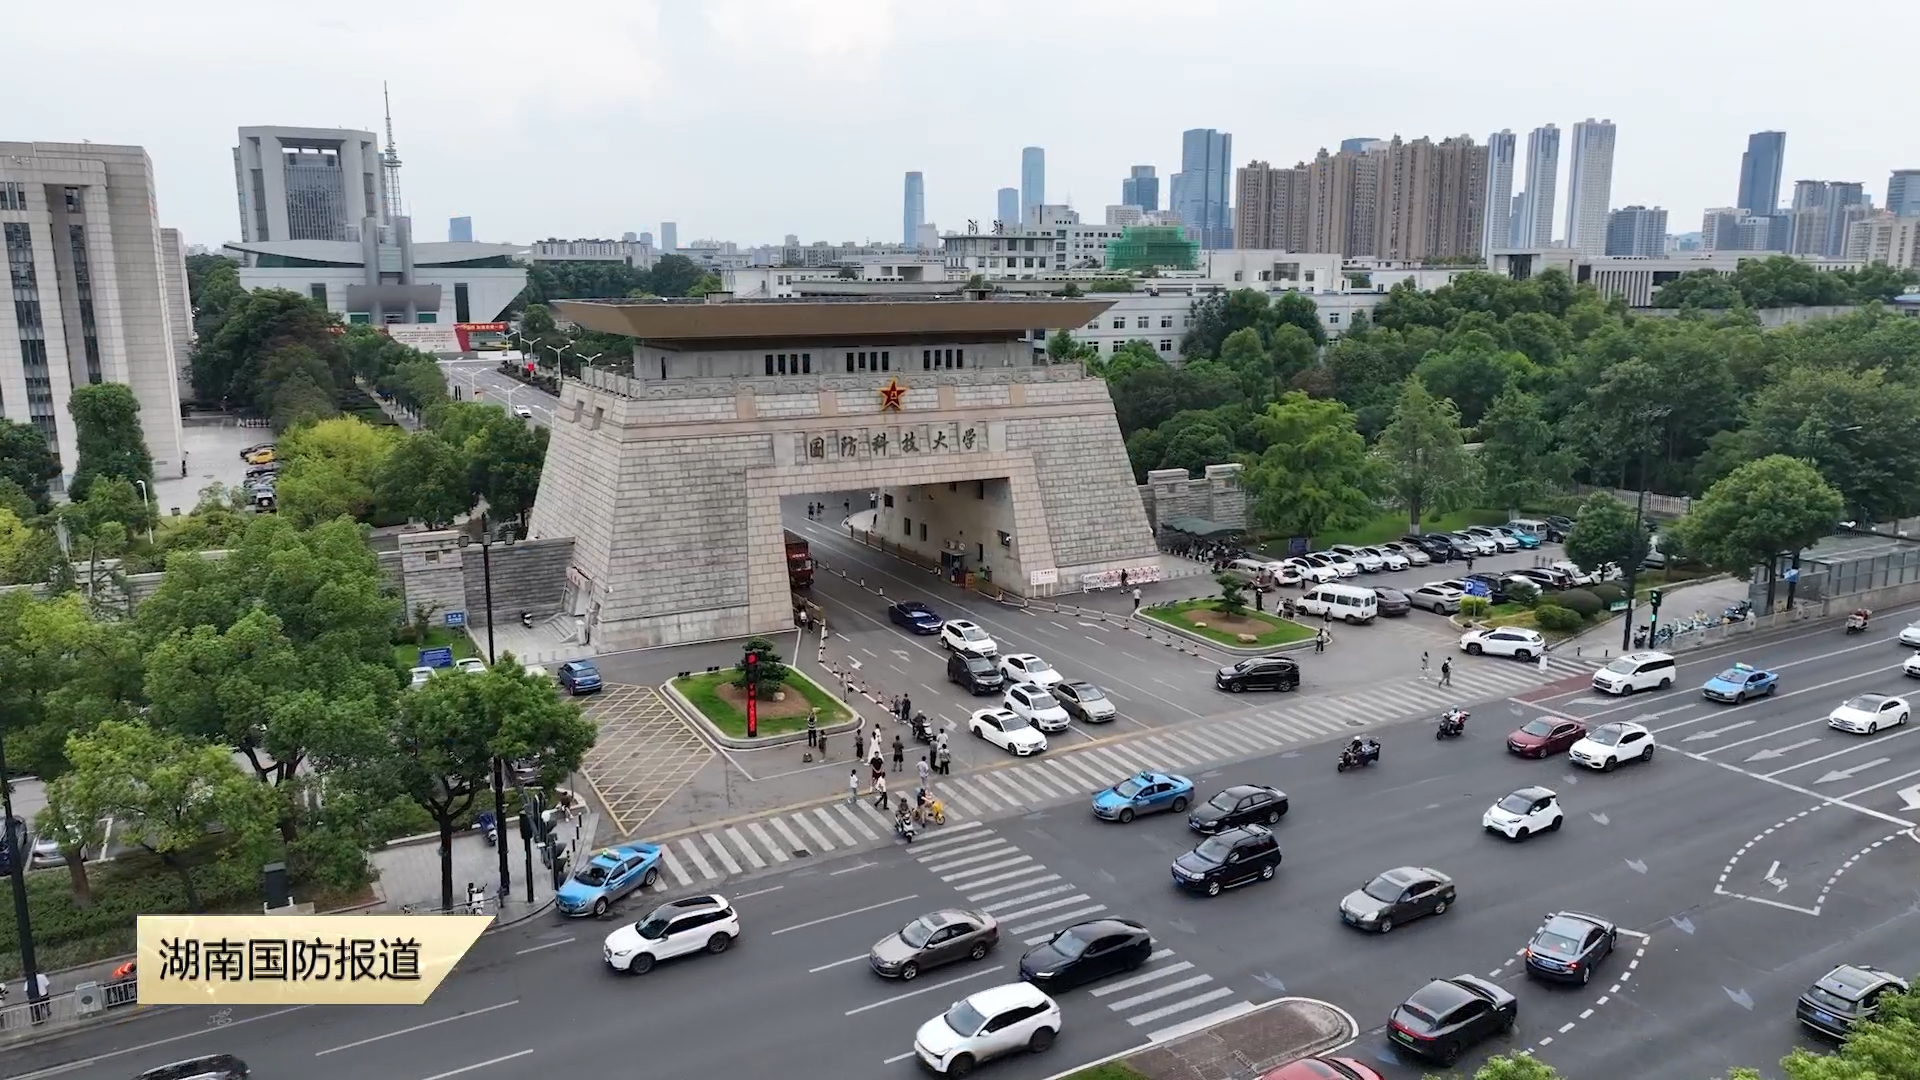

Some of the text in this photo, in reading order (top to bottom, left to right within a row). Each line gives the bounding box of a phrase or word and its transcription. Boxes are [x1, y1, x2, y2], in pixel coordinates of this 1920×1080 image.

[809, 428, 976, 459] 国防科技大学
